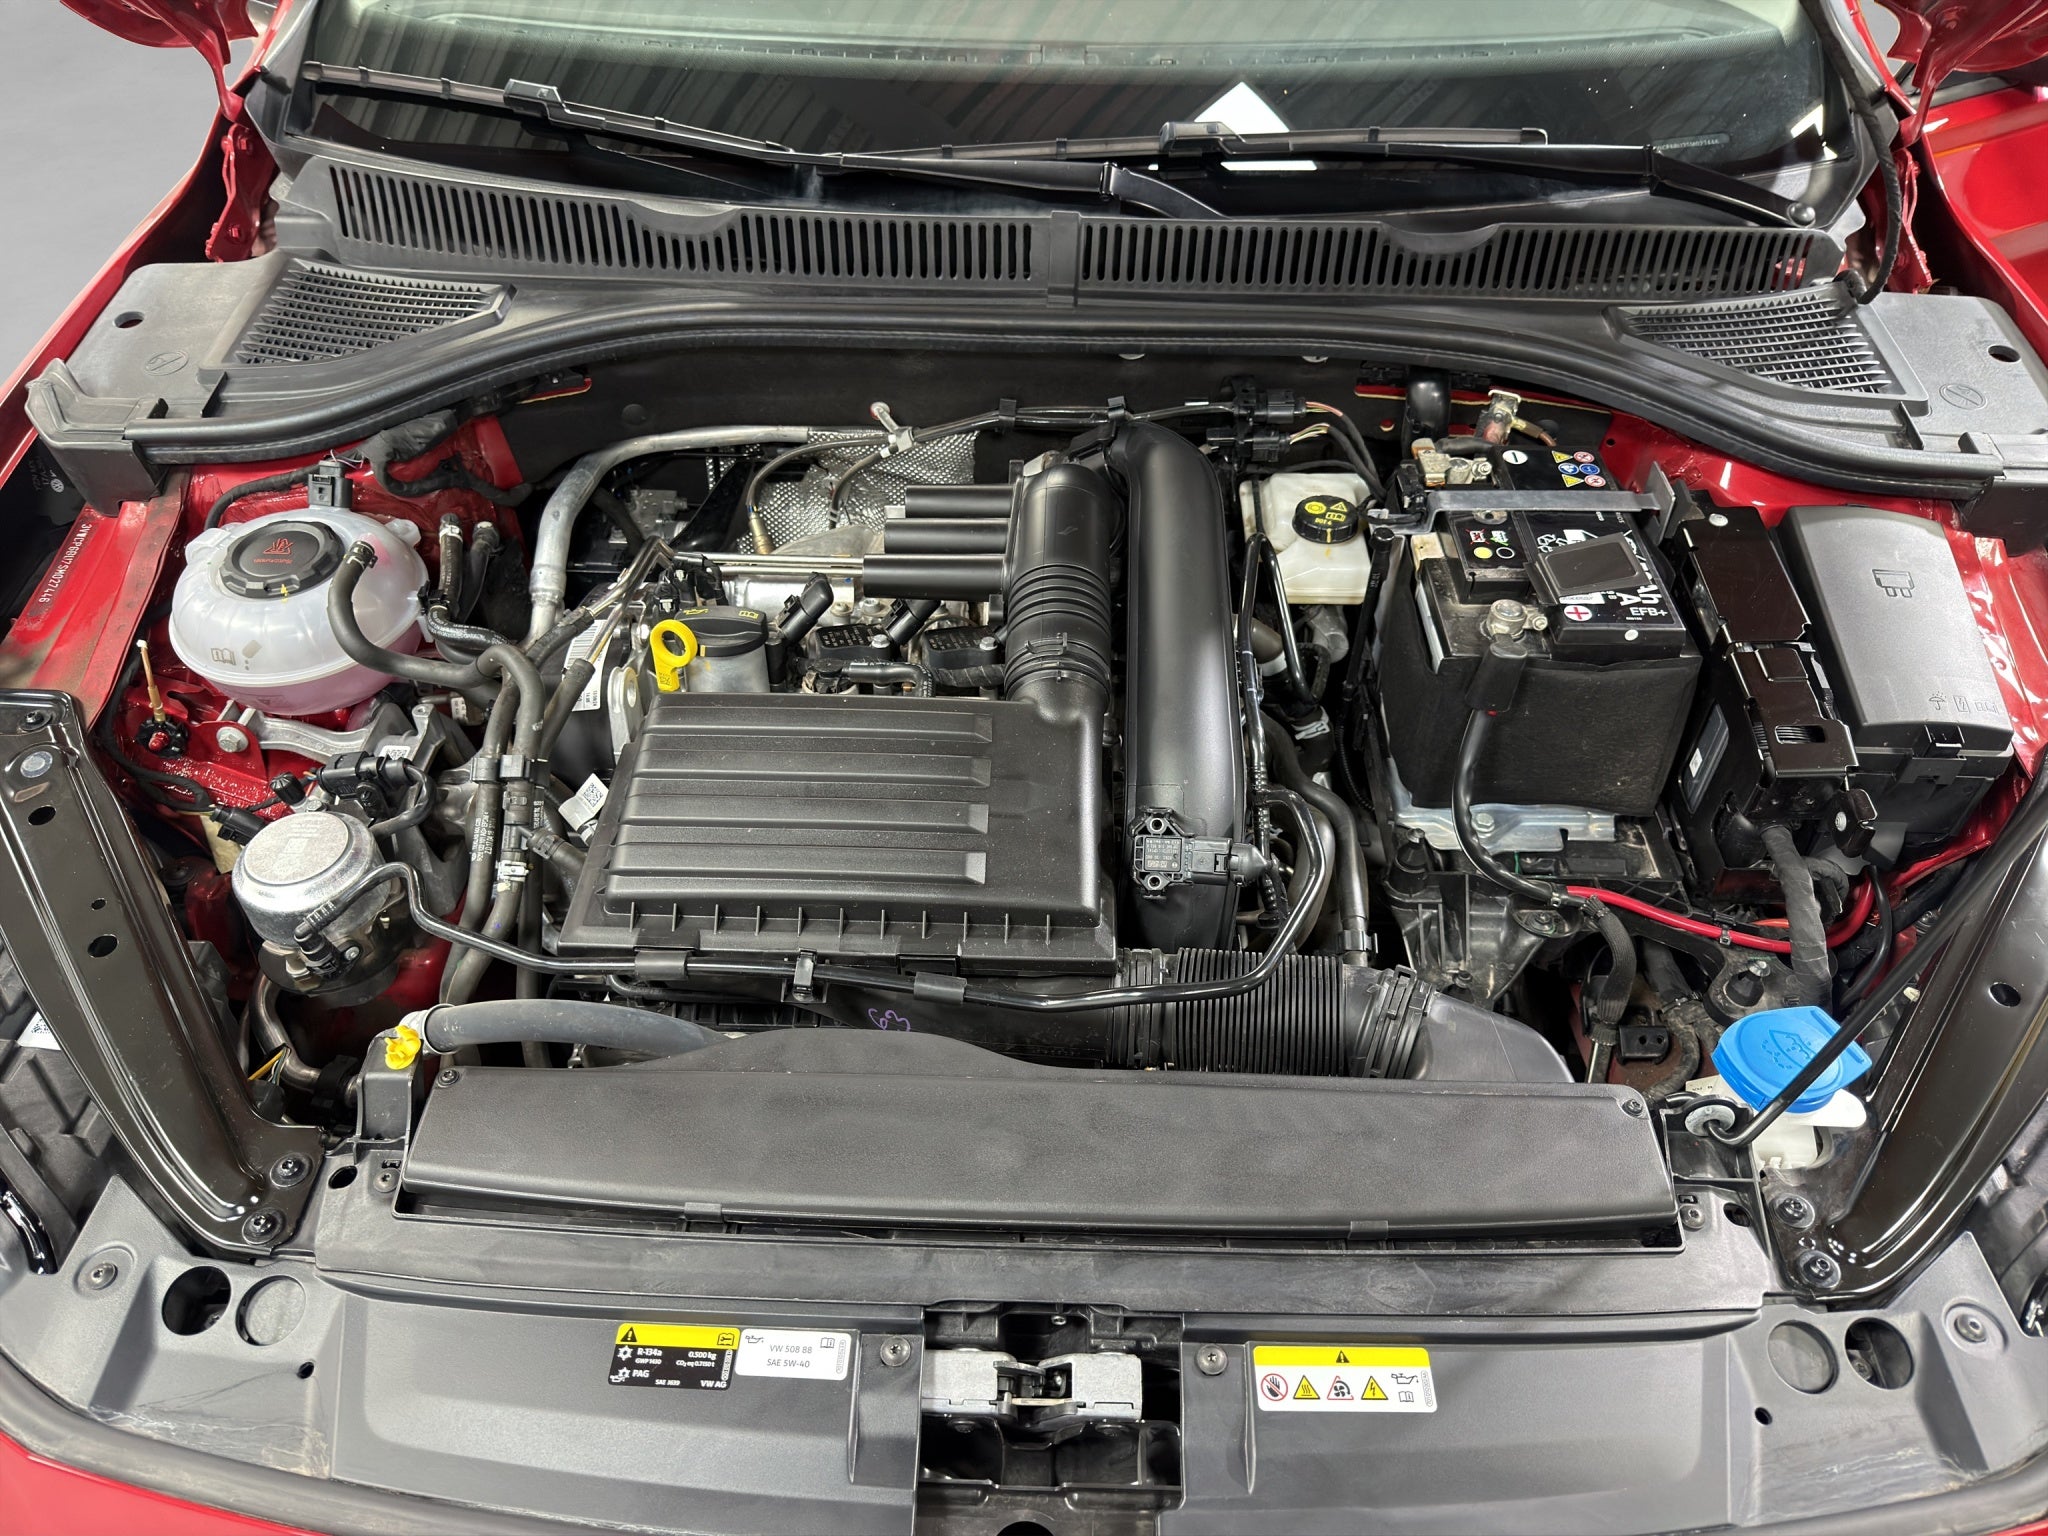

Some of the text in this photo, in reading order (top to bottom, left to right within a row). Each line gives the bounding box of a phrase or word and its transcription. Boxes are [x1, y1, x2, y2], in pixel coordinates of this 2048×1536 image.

[1629, 607, 1668, 617] EFB+
[637, 1347, 717, 1361] R-134a 0.500 kg
[769, 1344, 813, 1354] VW 508 88
[766, 1357, 810, 1368] SAE 5W-40
[632, 1369, 650, 1378] PAG
[700, 1379, 727, 1388] VW AG
